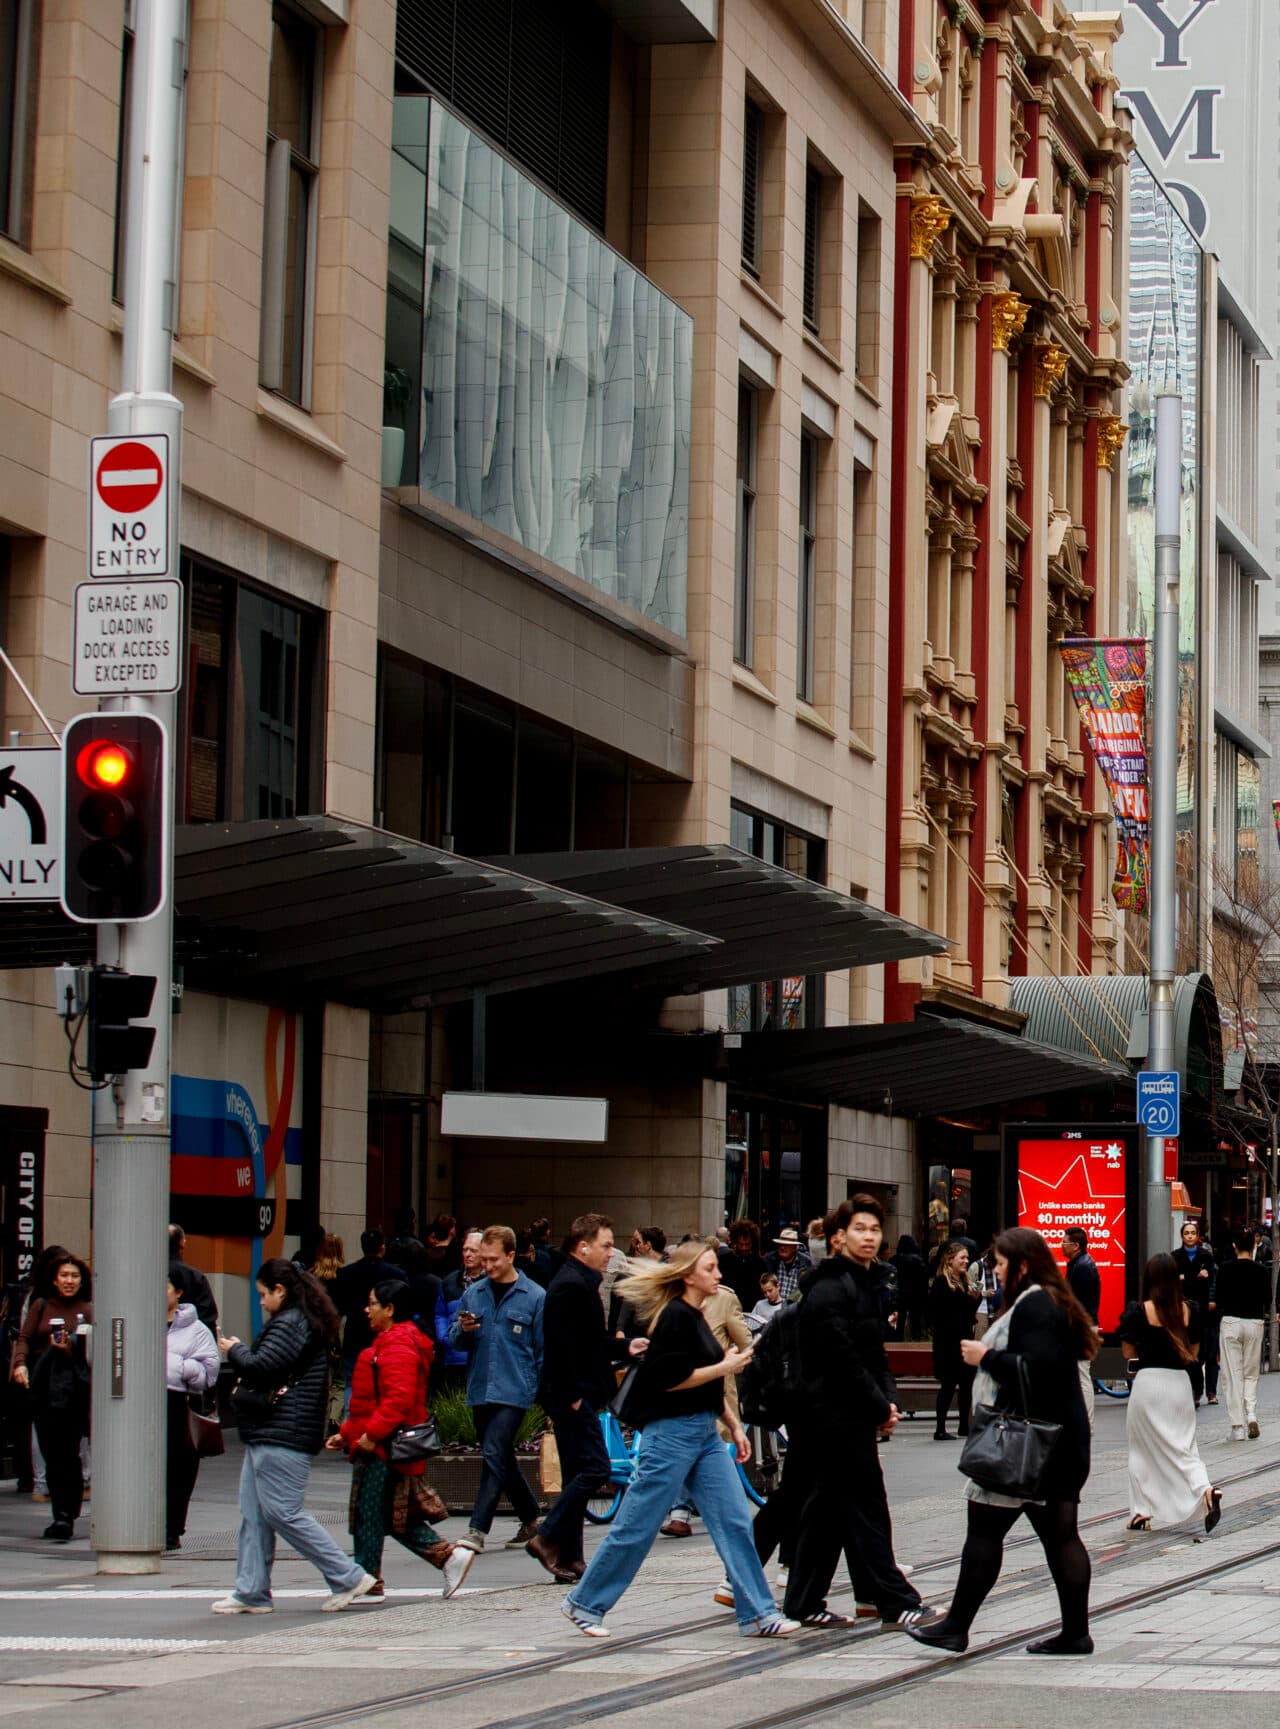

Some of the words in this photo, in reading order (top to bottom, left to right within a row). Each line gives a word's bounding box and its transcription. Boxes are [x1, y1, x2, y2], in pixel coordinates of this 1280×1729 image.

[112, 522, 146, 541] NO
[97, 549, 160, 566] ENTRY
[88, 596, 137, 612] GARAGE
[143, 594, 168, 610] AND
[101, 618, 153, 635] LOADING
[84, 643, 116, 659] DOCK
[122, 640, 170, 657] ACCESS
[95, 664, 157, 682] EXCEPTED
[1147, 1107, 1169, 1124] 20
[1106, 1161, 1120, 1169] nab
[19, 1151, 35, 1211] CITY
[236, 1167, 251, 1187] we
[259, 1205, 272, 1231] go
[1037, 1213, 1053, 1225] $0
[1055, 1212, 1106, 1225] monthly
[18, 1217, 34, 1248] OF
[1088, 1226, 1110, 1238] fee
